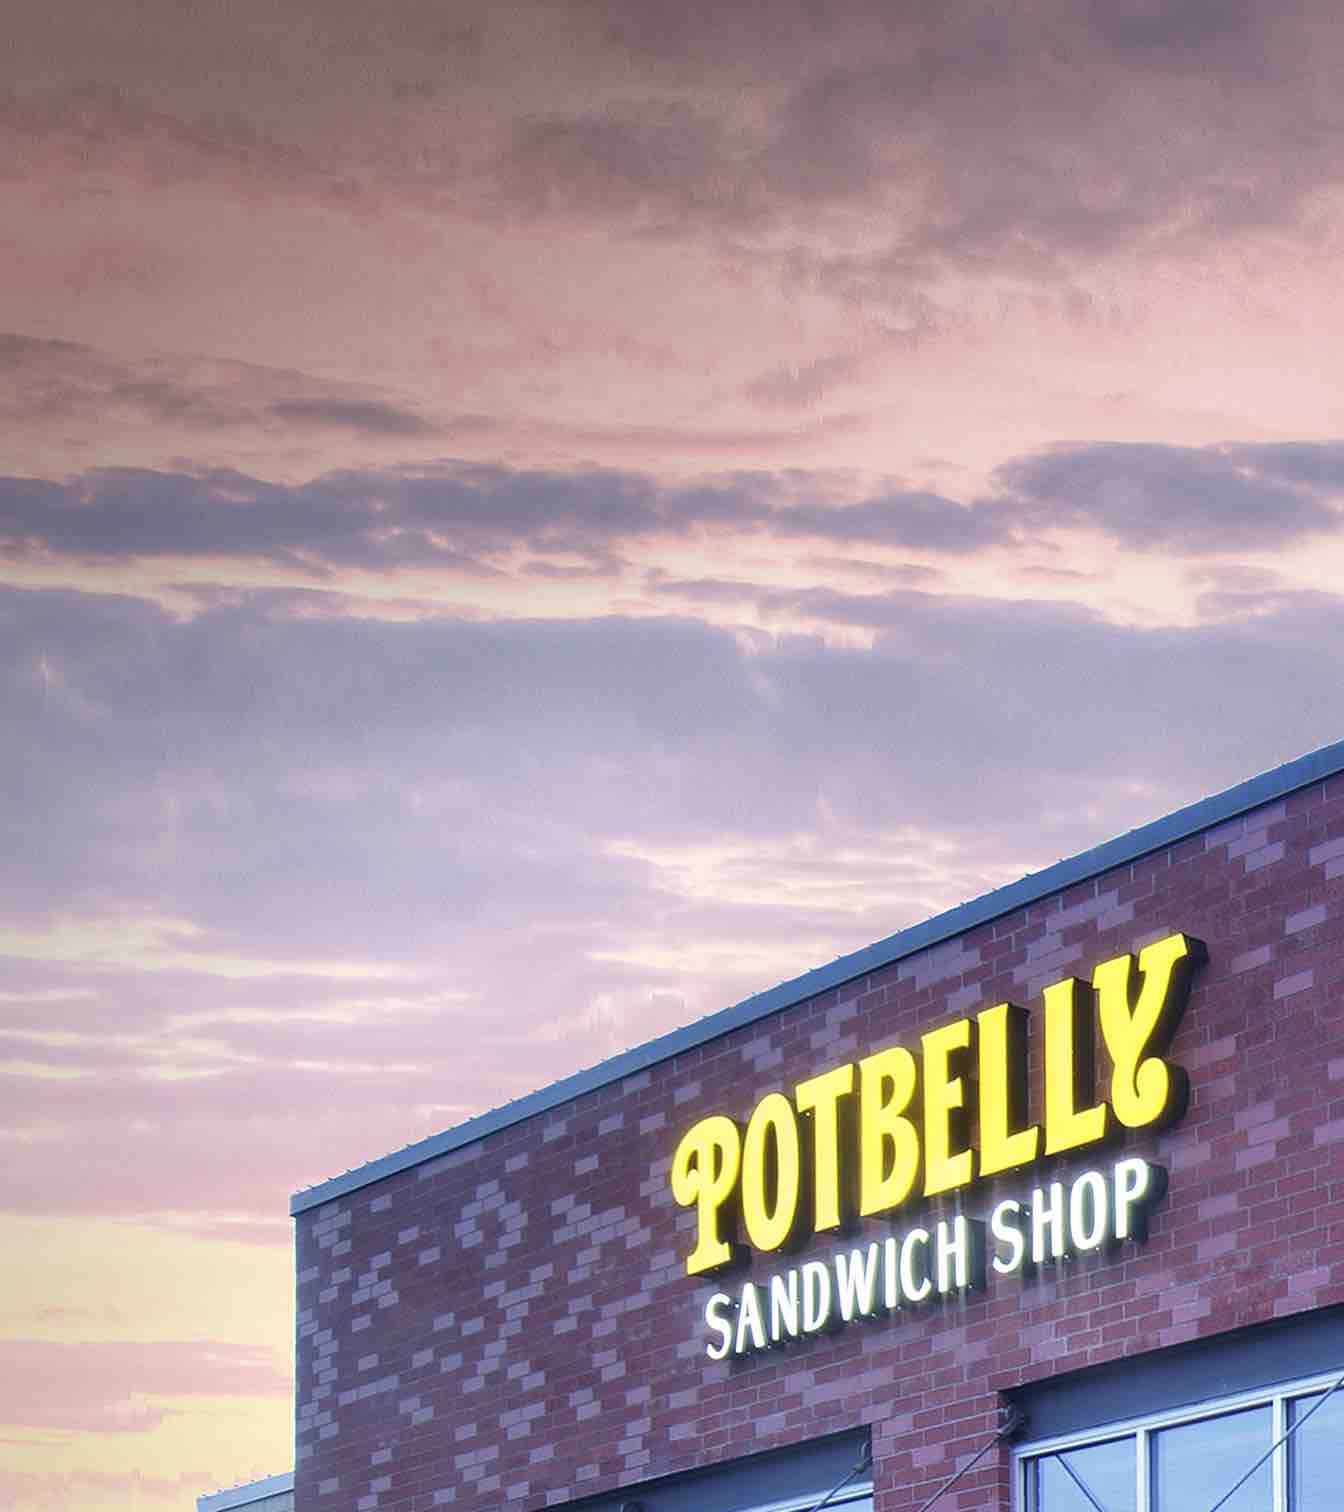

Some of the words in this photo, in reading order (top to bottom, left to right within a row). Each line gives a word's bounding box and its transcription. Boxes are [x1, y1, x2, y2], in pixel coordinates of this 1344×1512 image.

[671, 931, 1189, 1275] POTBELLY
[704, 1215, 967, 1360] SANDWICH
[990, 1157, 1151, 1275] SHOP
